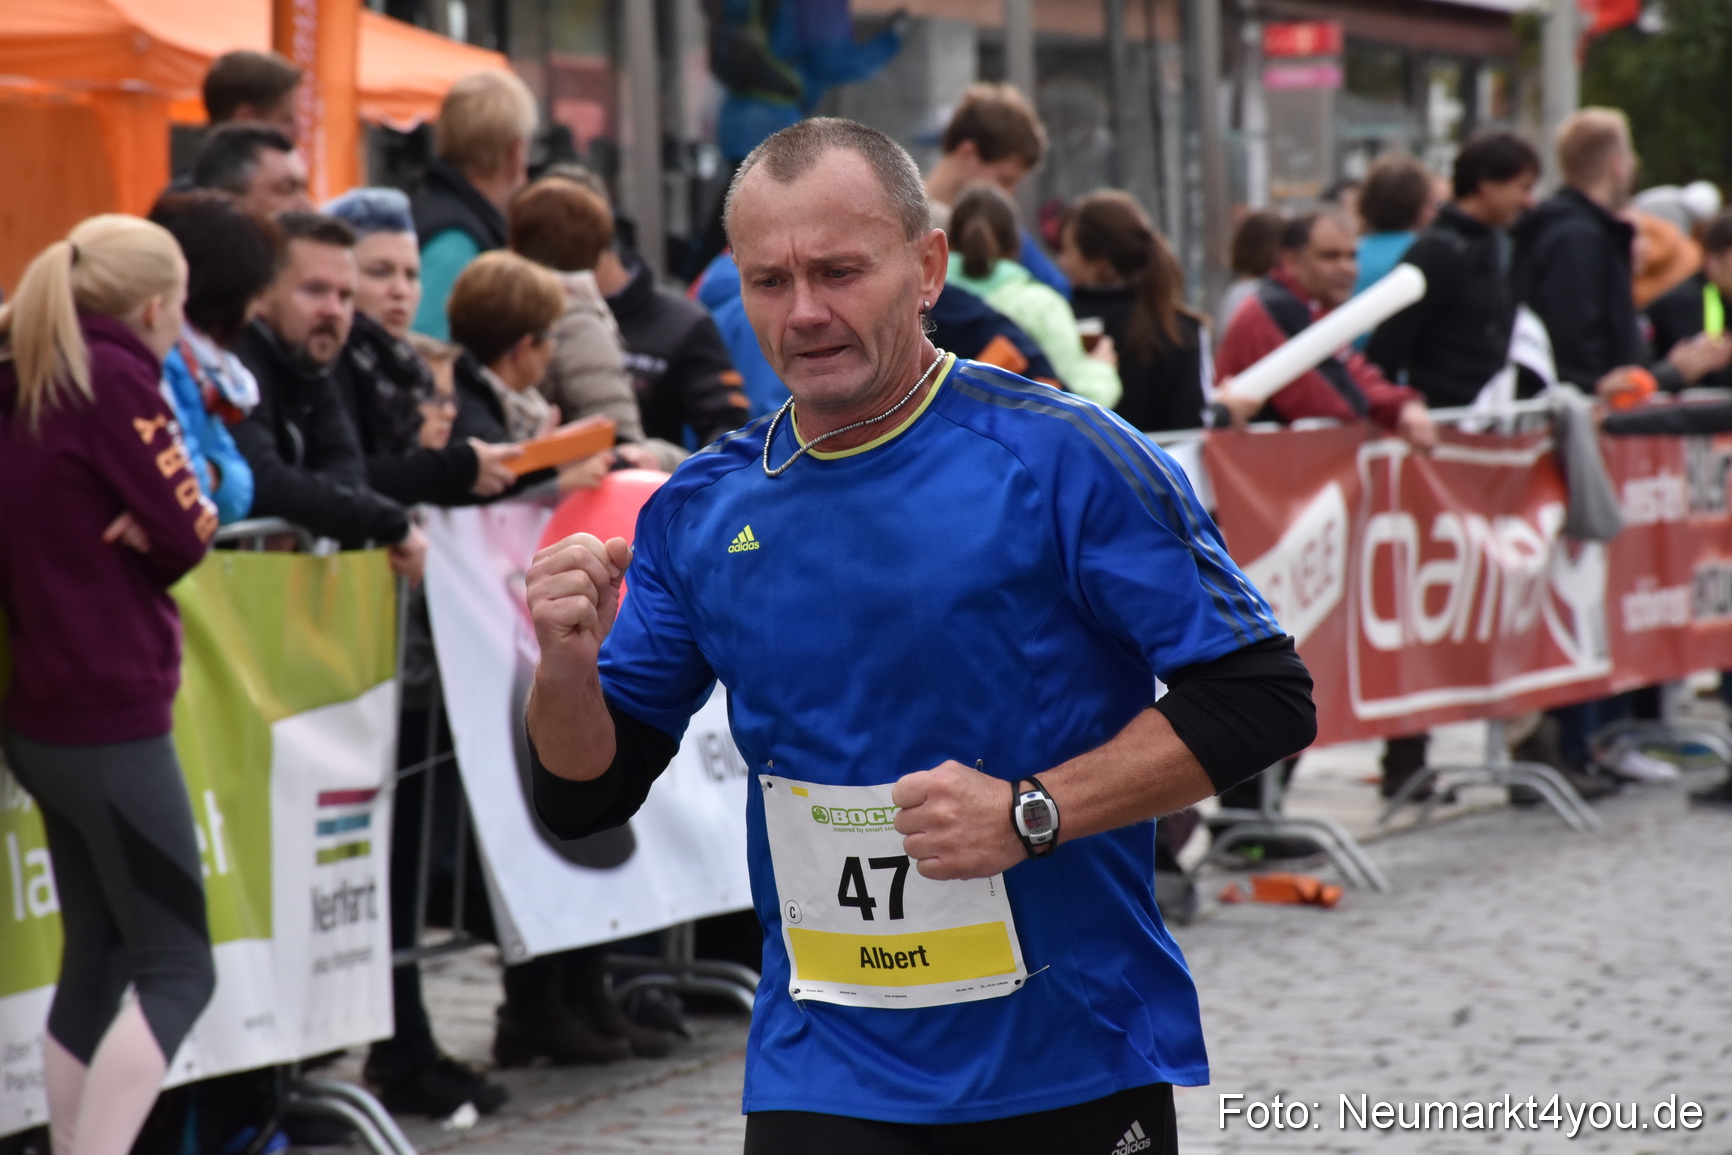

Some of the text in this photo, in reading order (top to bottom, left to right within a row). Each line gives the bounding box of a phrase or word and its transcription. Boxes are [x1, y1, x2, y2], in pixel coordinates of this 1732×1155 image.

[728, 541, 760, 554] adidas
[833, 826, 856, 834] inspired
[856, 826, 864, 834] by
[837, 854, 910, 921] 47
[789, 906, 796, 919] C
[859, 944, 930, 970] Albert
[1111, 1137, 1151, 1155] adidas
